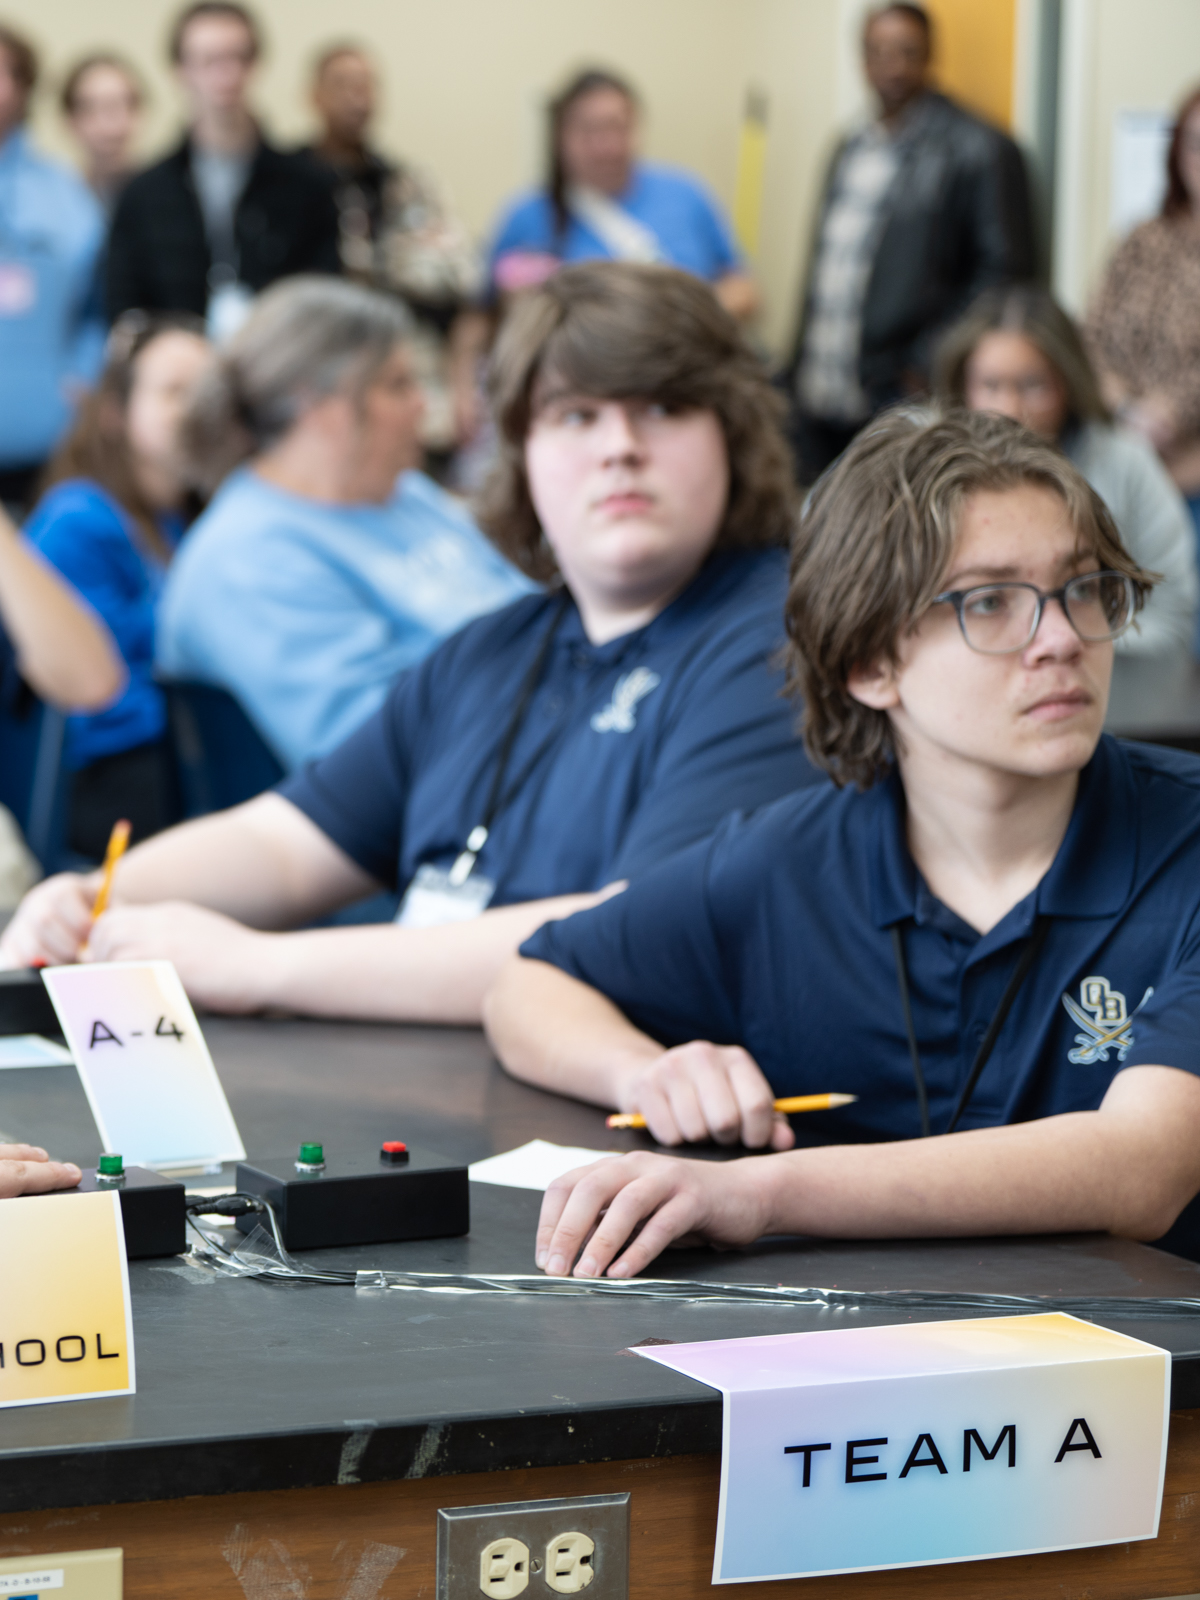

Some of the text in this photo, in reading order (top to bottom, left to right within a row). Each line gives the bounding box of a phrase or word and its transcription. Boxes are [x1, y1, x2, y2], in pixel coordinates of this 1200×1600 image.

[89, 1015, 185, 1049] A-4
[783, 1417, 1103, 1489] TEAM A
